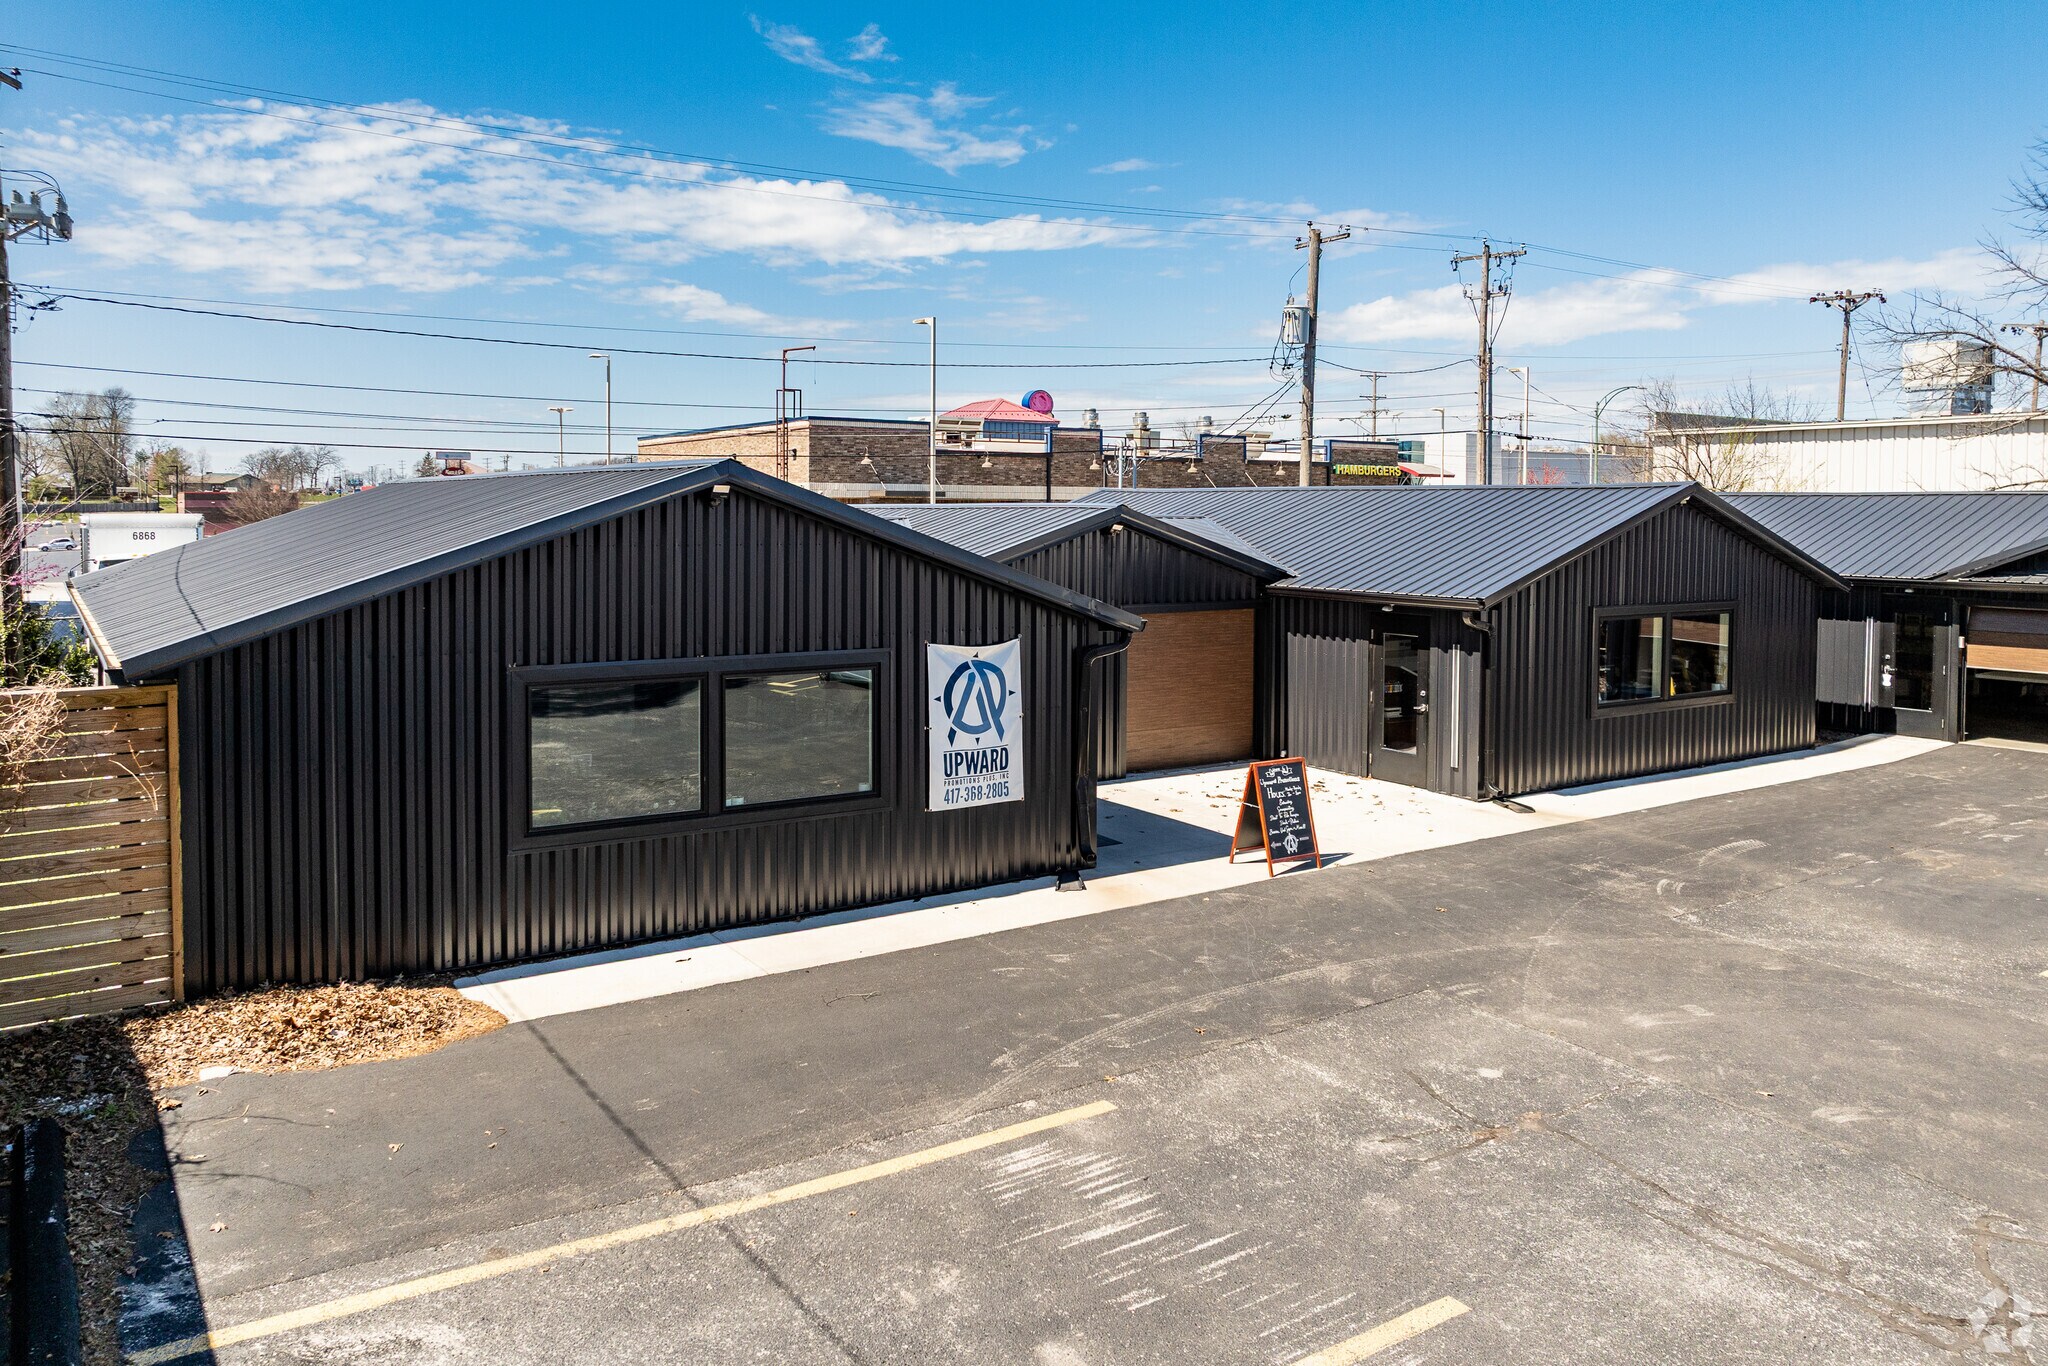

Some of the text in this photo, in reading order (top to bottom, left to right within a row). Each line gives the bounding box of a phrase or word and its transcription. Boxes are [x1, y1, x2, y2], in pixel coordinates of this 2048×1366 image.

[1337, 464, 1402, 477] HAMBURGERS
[132, 531, 156, 541] 6868
[943, 747, 1009, 778] UPWARD
[944, 777, 981, 787] PROMOTIONS
[944, 781, 1010, 805] 417-368-2805
